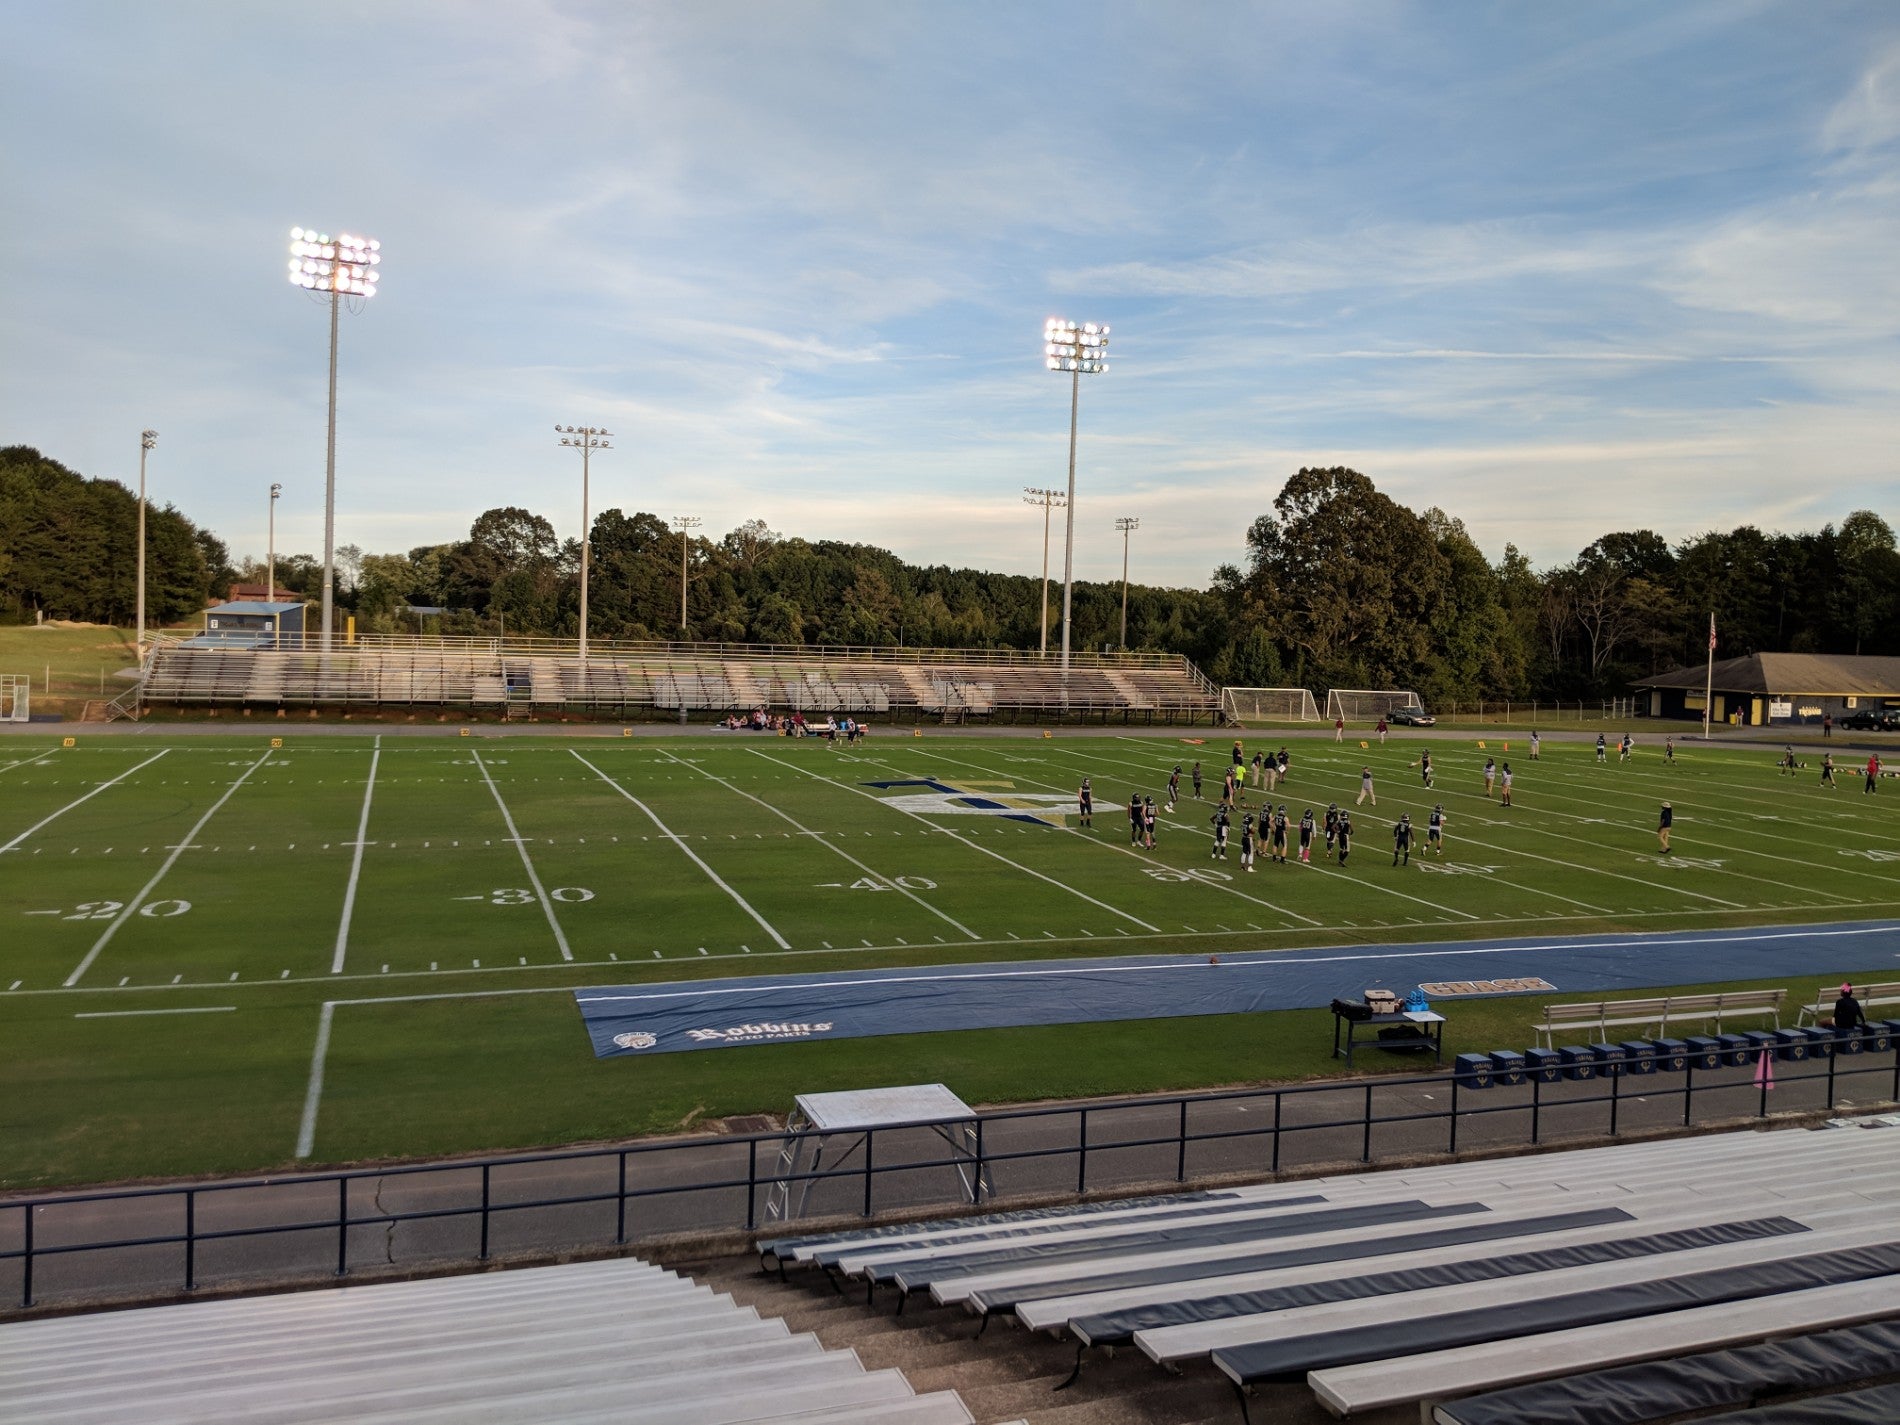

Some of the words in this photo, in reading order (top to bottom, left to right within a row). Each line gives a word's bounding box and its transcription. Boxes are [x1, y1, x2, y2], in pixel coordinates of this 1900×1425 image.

[1302, 820, 1311, 829] 20
[1140, 868, 1234, 881] 50
[850, 876, 938, 891] 40
[492, 887, 596, 904] 30
[63, 900, 192, 919] 20
[1419, 977, 1558, 996] CHASE
[686, 1022, 834, 1042] Robbins
[724, 1034, 764, 1042] AUTO
[766, 1032, 811, 1040] PARTS
